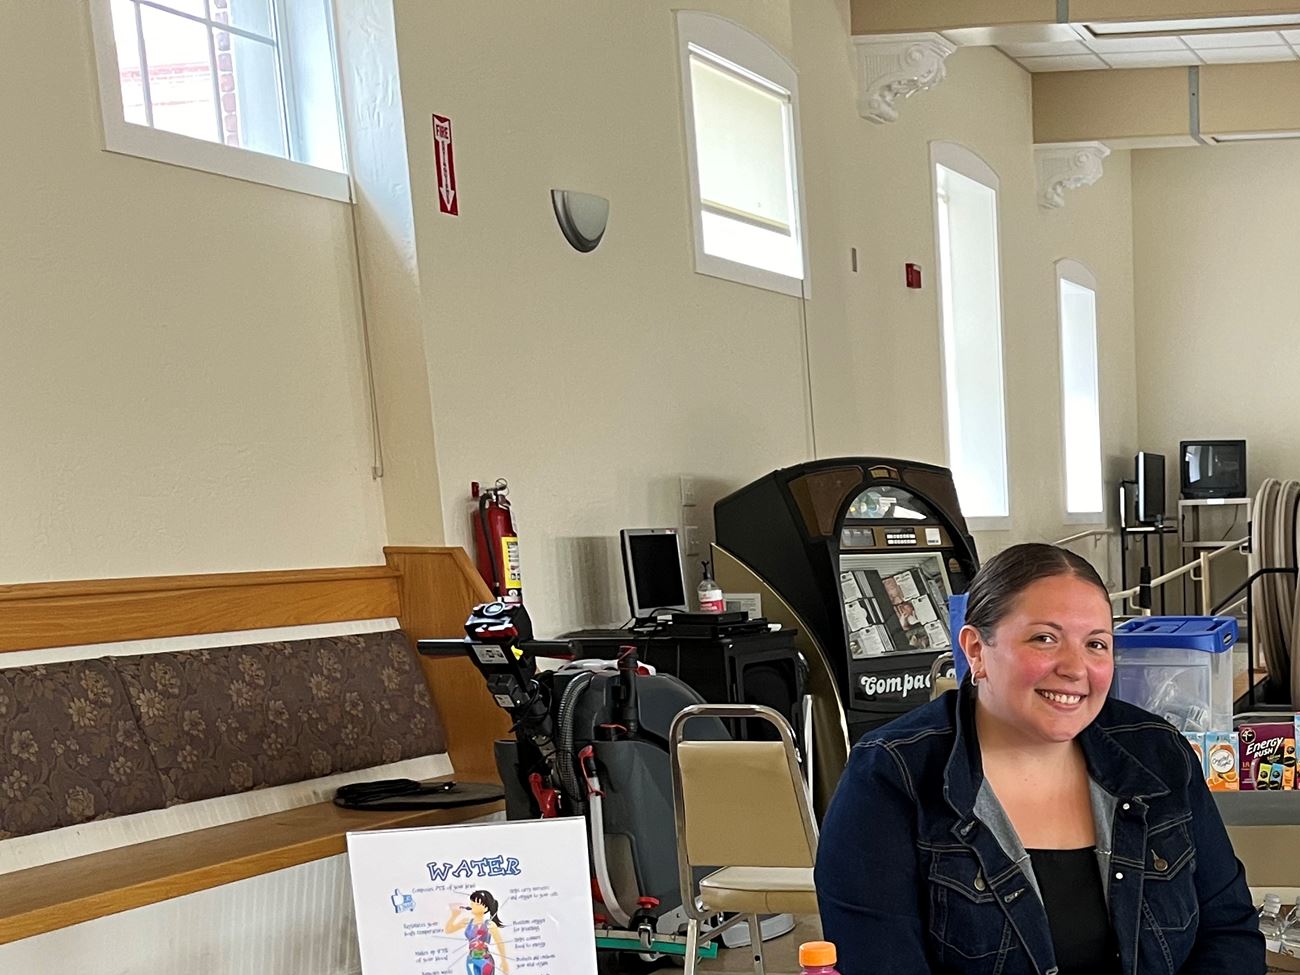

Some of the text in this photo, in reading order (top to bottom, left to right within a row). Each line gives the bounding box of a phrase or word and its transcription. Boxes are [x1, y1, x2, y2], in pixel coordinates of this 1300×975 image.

[1246, 737, 1284, 756] Energy
[1254, 748, 1274, 758] RUSH
[426, 855, 521, 881] WATER
